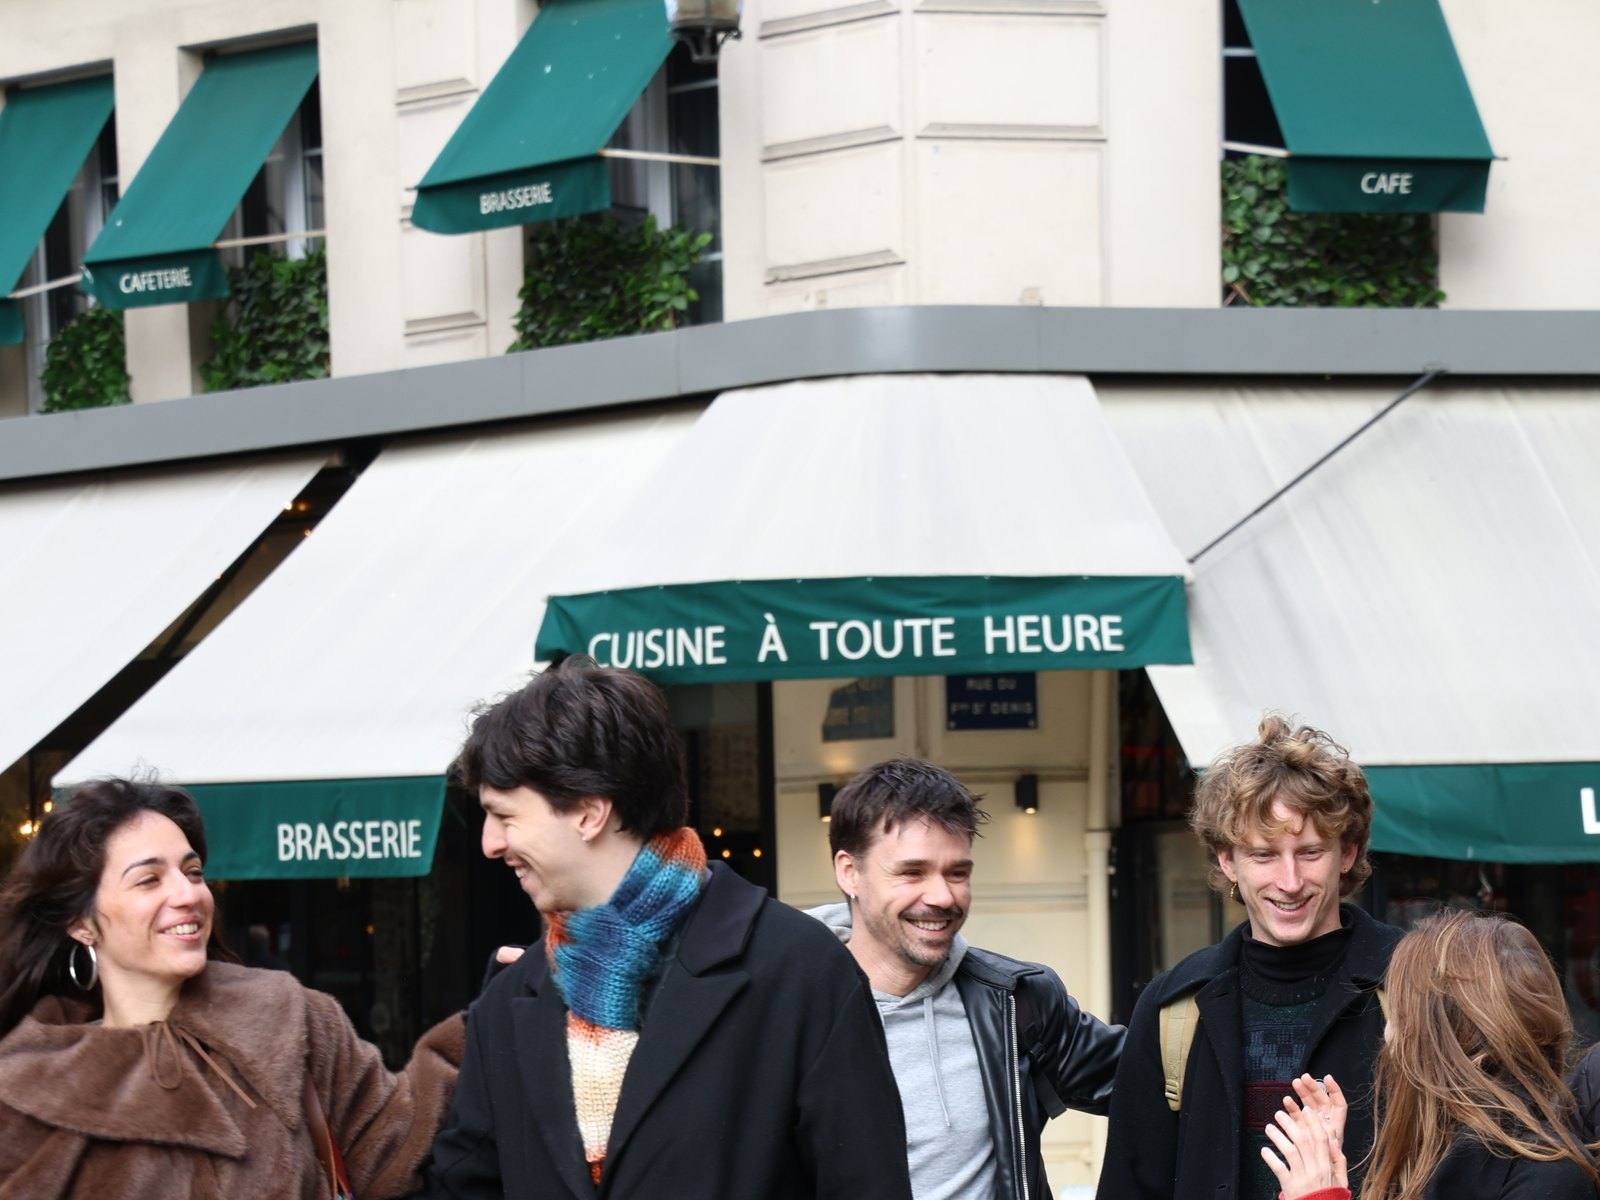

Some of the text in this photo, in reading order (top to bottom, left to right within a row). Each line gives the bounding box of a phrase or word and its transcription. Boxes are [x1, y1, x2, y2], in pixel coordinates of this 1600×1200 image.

[479, 182, 553, 214] BRASSERIE
[1361, 172, 1413, 194] CAFE
[119, 266, 192, 293] CAFETERIE
[588, 612, 1125, 669] CUISINE À TOUTE HEURE
[277, 819, 422, 861] BRASSERIE
